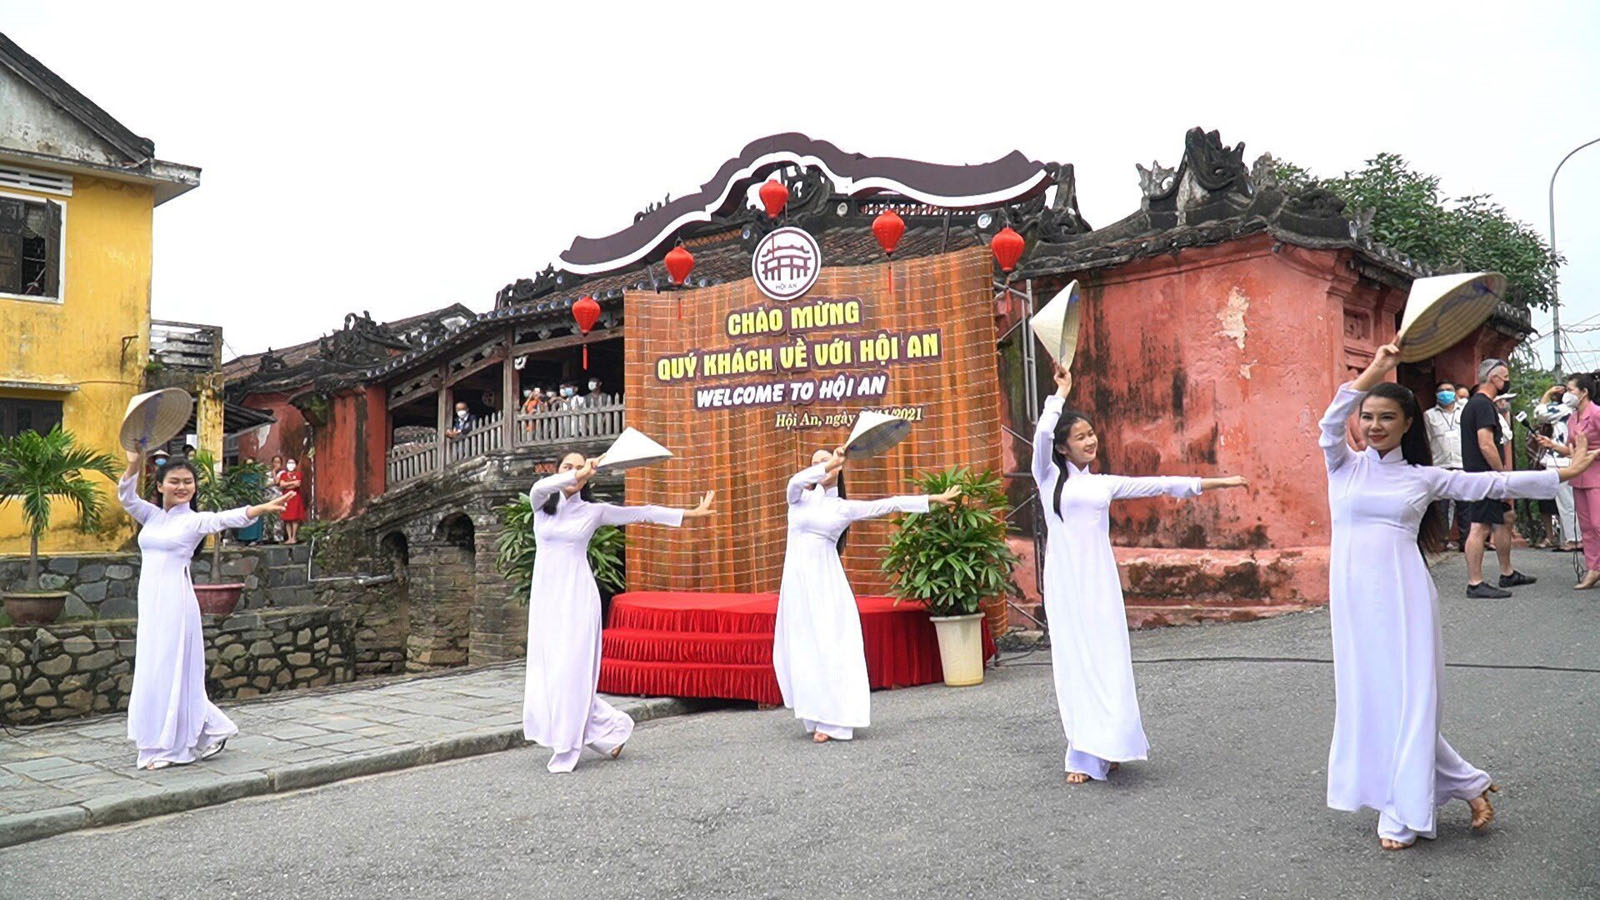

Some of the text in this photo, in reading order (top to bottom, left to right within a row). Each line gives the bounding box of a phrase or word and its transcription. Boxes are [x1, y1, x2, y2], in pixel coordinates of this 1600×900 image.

[728, 300, 860, 336] CHÀO MỪNG
[657, 332, 938, 380] QUÝ KHÁCH VỀ VỚI HỘI AN
[697, 374, 886, 408] WELCOME TO HỘI AN
[775, 407, 922, 429] Hội An, ngày /2021
